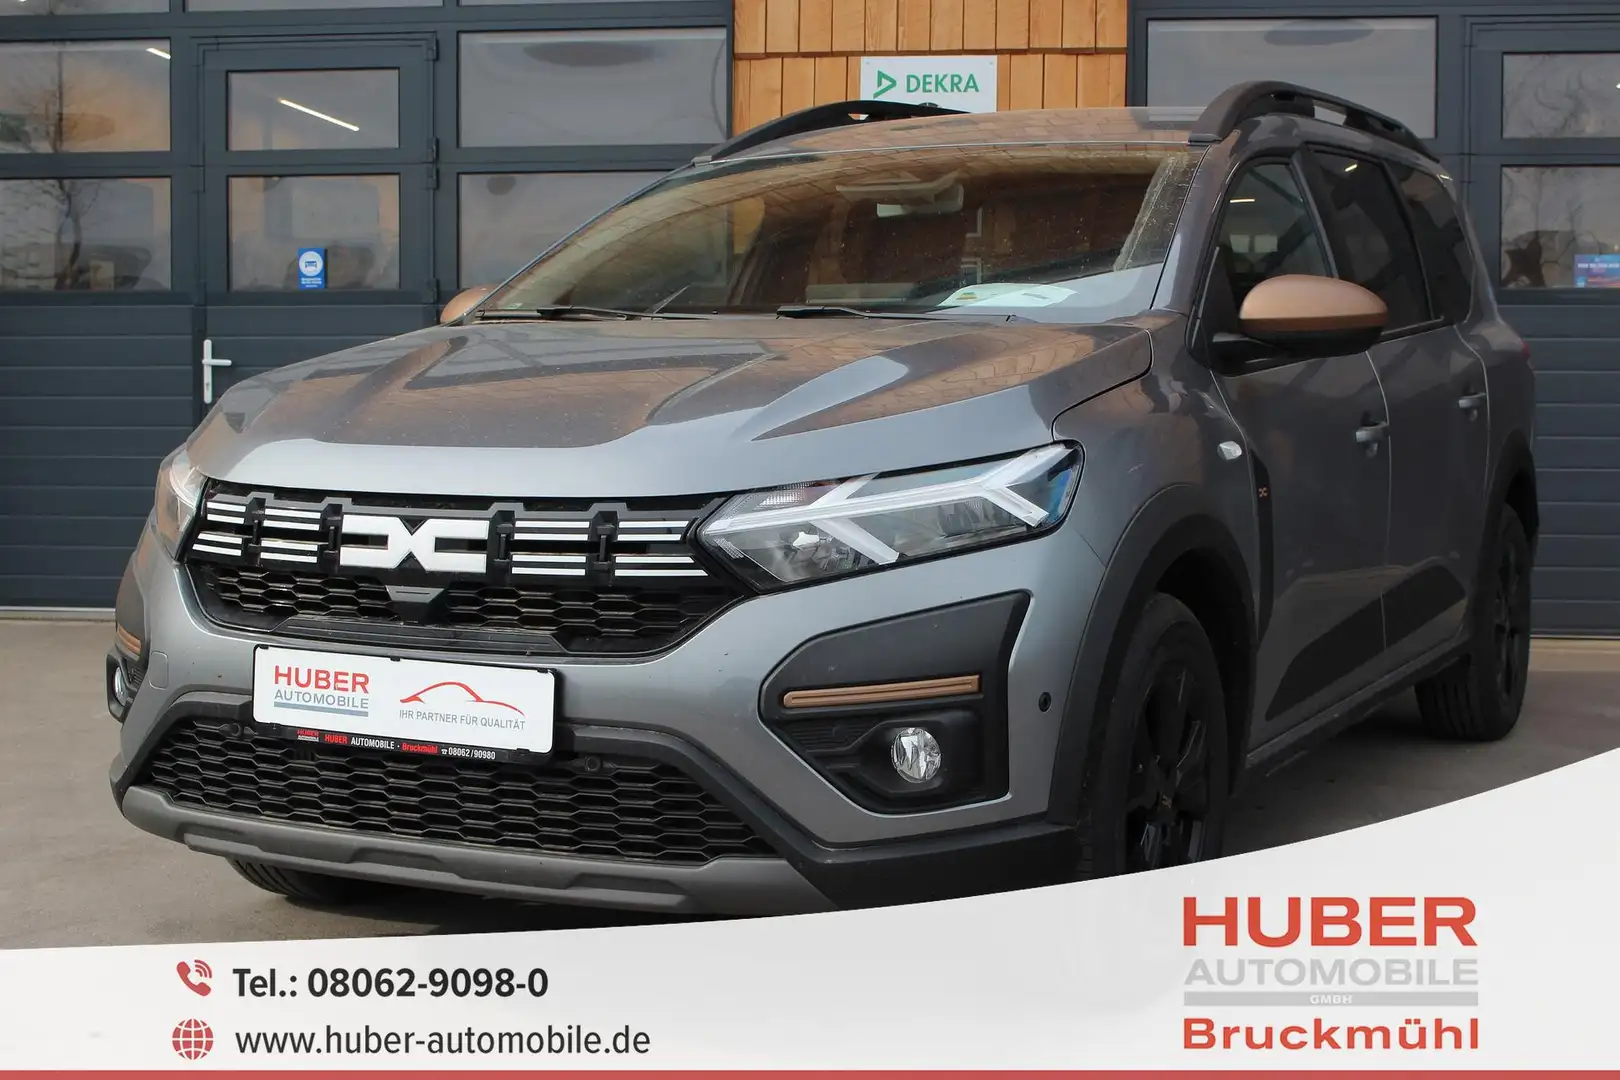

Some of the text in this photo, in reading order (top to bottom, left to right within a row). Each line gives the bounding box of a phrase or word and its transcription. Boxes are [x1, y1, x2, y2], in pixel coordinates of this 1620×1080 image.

[906, 73, 980, 93] DEKRA
[274, 665, 369, 694] HUBER
[274, 689, 369, 709] AUTOMOBILE
[400, 709, 526, 731] IHR PARTNER FÜR QUALITÄT
[324, 734, 348, 745] HUBER
[350, 736, 395, 750] AUTOMOBILE
[402, 742, 438, 754] Bruckmühl
